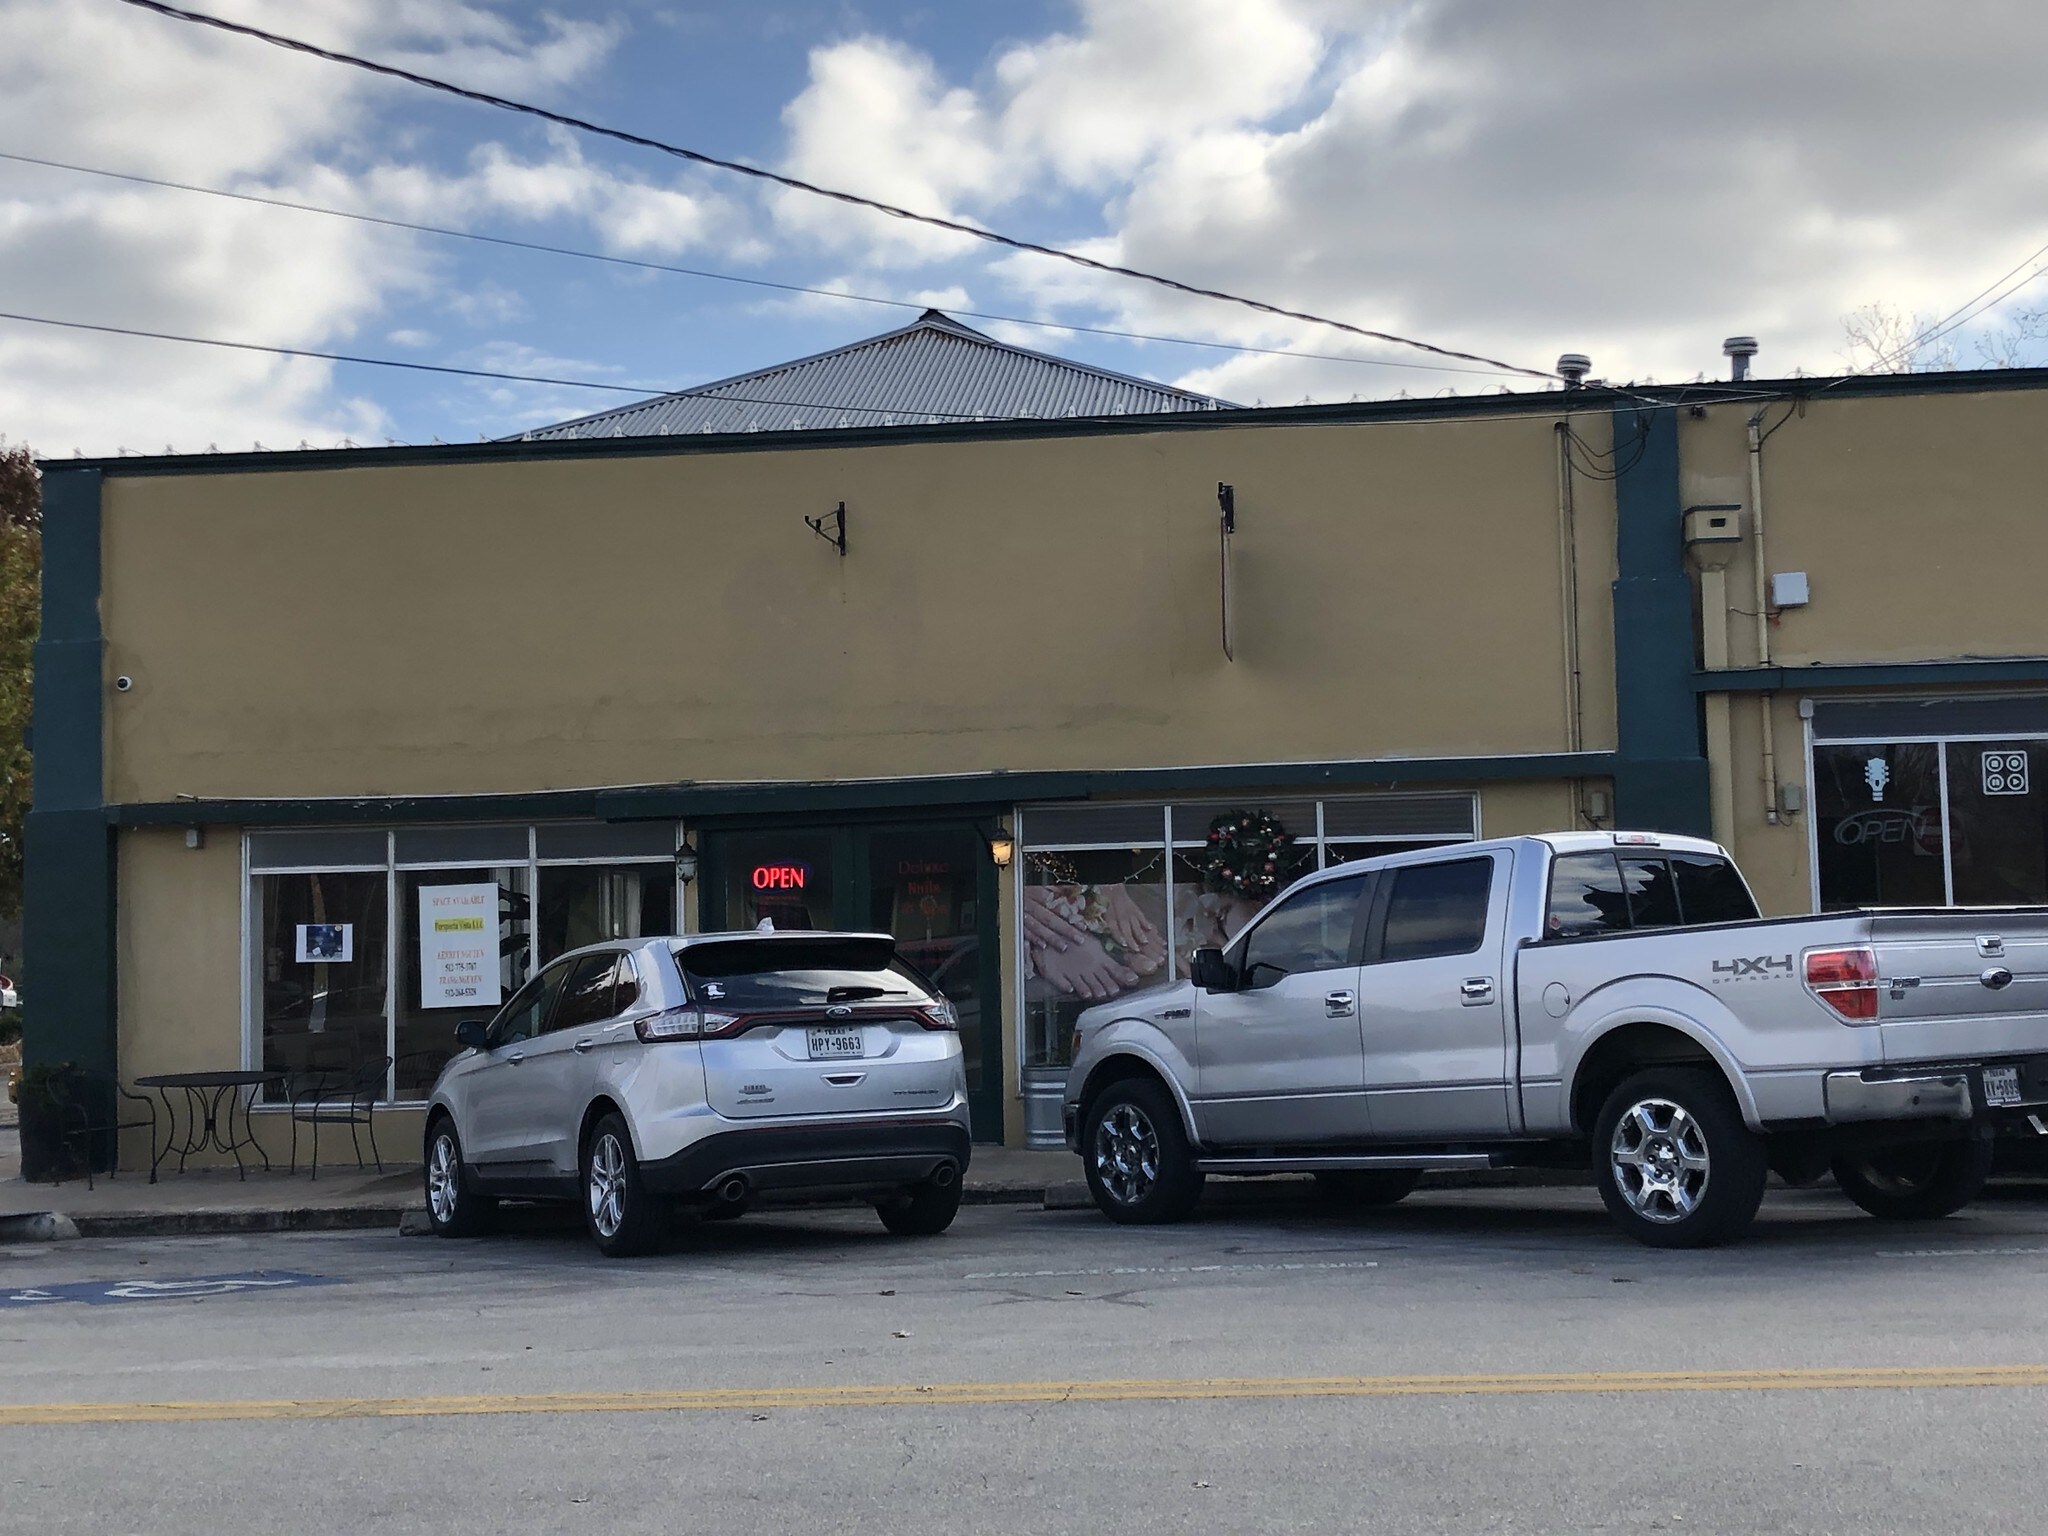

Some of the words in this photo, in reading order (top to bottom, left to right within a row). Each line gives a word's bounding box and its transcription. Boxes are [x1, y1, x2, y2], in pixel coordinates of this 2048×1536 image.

[1838, 817, 1928, 845] OPEN
[753, 867, 804, 889] OPEN
[433, 897, 451, 906] SPACE
